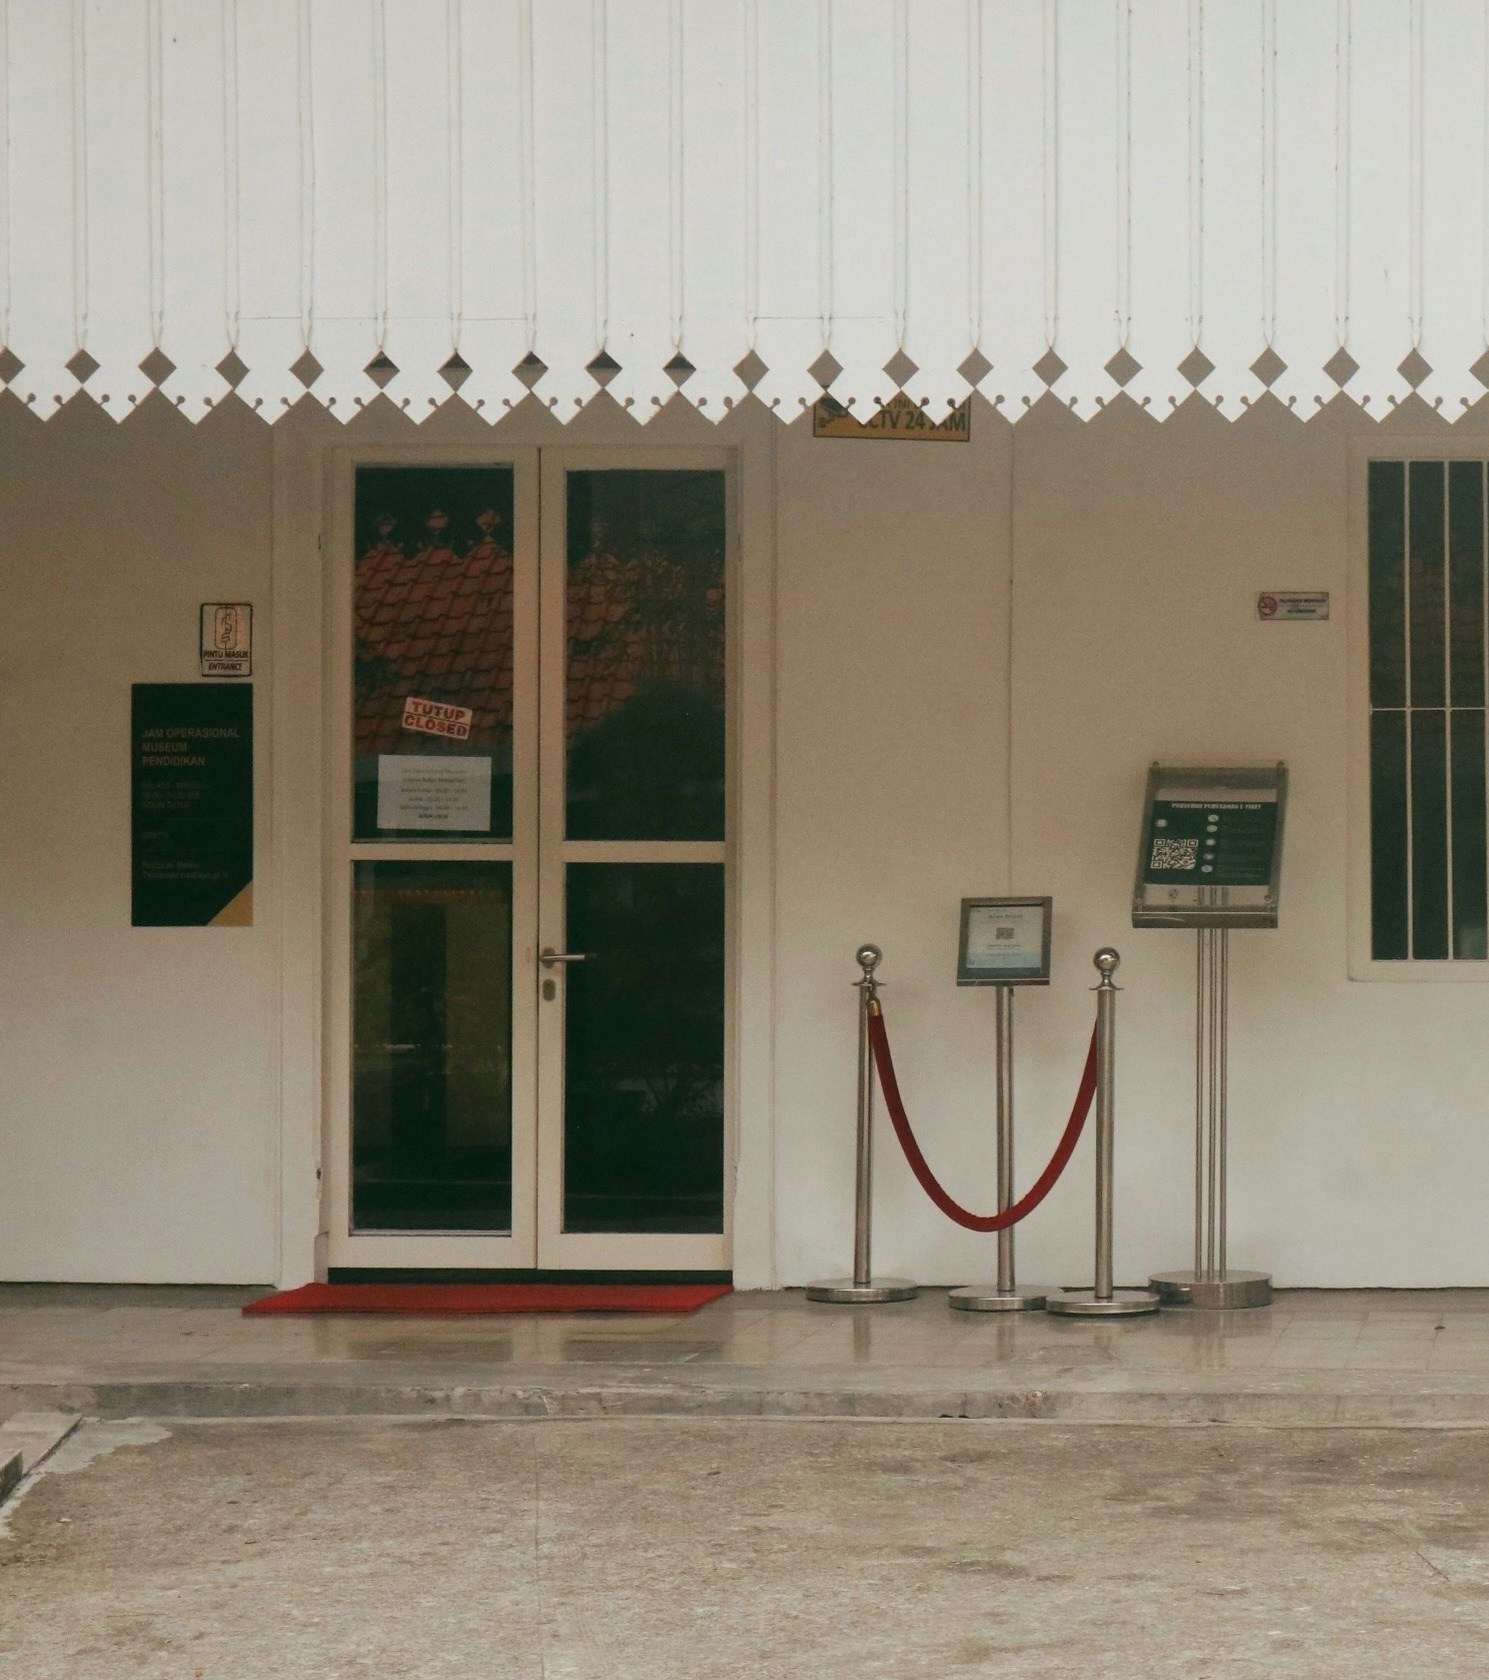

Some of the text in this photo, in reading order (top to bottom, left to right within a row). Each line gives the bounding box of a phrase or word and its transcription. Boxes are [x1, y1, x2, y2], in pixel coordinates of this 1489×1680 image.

[905, 411, 924, 429] 24
[412, 701, 466, 721] TUTUP
[142, 728, 239, 738] JAM OPERASIONAL
[404, 715, 467, 737] CLOSED
[142, 742, 187, 752] MUSEUM
[142, 756, 205, 766] PENDIDIKAN
